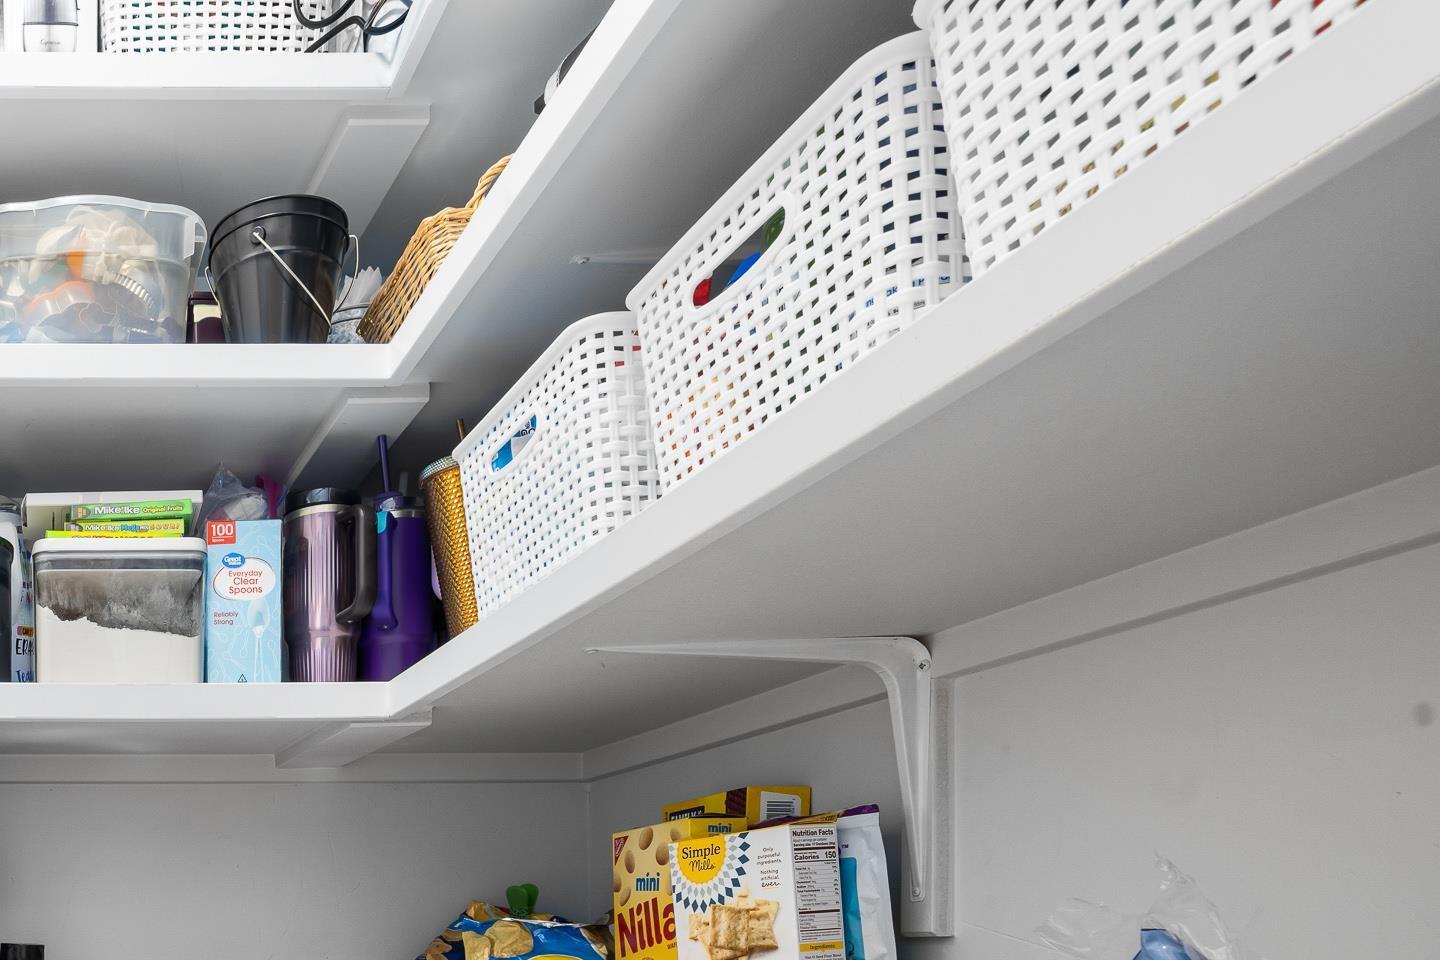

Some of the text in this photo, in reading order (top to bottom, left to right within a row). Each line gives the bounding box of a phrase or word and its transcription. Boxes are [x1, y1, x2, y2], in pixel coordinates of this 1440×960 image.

[211, 524, 234, 537] 100
[228, 570, 263, 579] Everyday
[233, 577, 258, 586] Clear
[228, 586, 263, 596] Spoons
[213, 611, 239, 619] Reliably
[213, 619, 234, 627] Strong
[792, 828, 834, 838] Nutrition Facts
[681, 843, 721, 861] Simple
[794, 850, 837, 862] Calories 150
[688, 860, 716, 872] Mills
[635, 872, 661, 892] mini
[616, 897, 677, 958] Nilla
